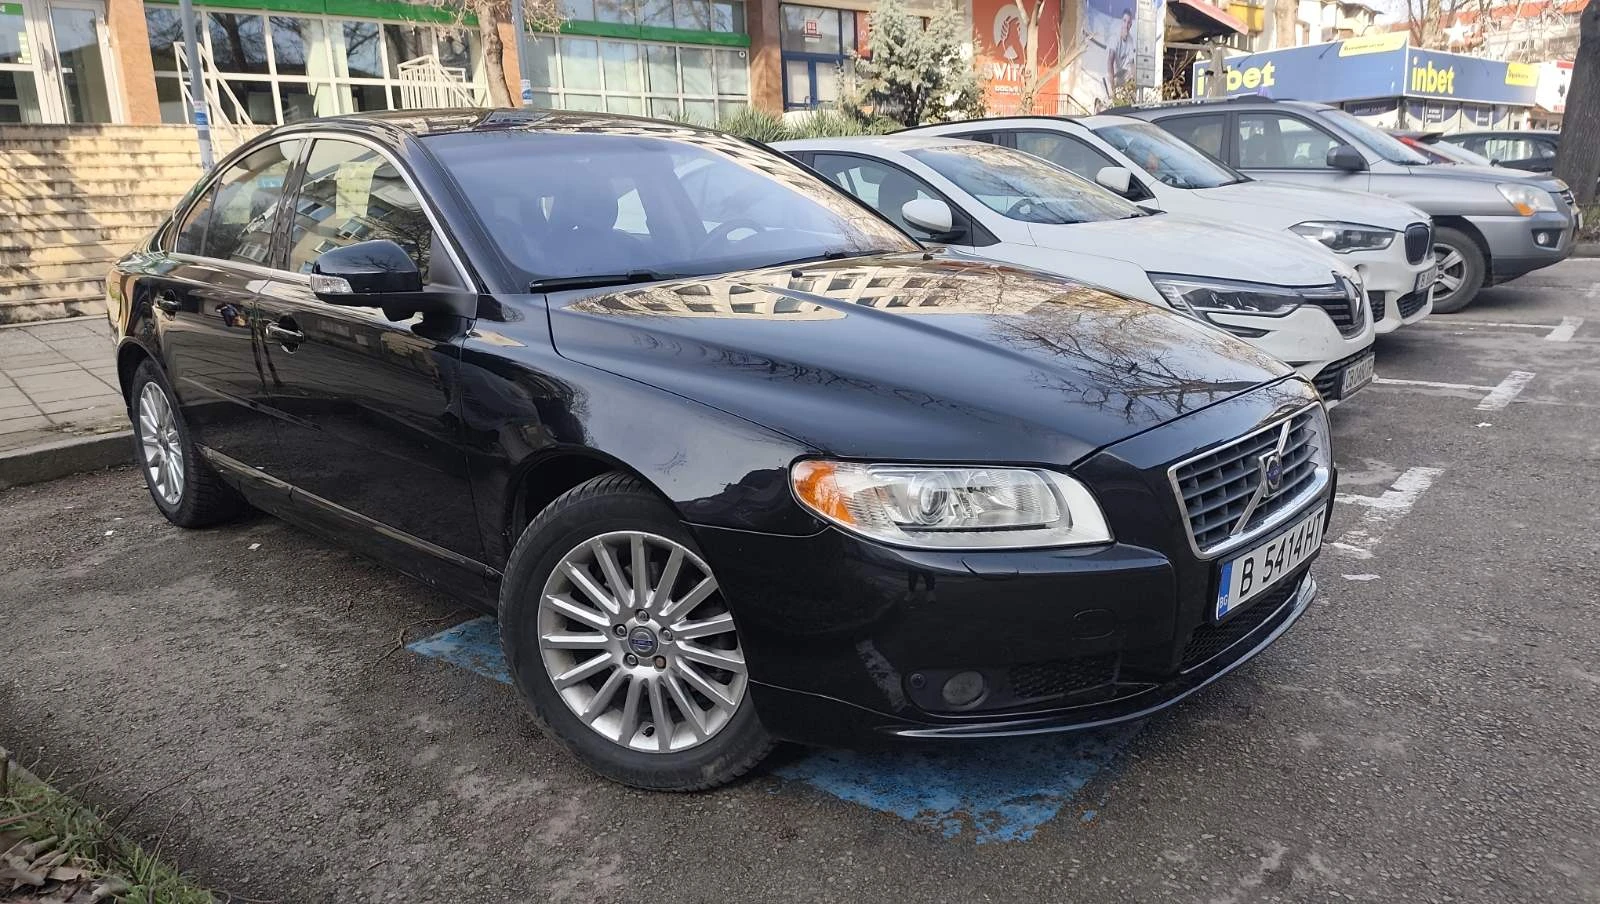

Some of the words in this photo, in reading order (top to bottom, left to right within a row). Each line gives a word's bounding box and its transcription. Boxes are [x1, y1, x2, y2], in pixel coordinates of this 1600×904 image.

[1197, 60, 1276, 96] ibet
[1411, 56, 1455, 95] inbet
[1239, 556, 1254, 598] B
[1262, 509, 1324, 583] 5414HT
[1218, 593, 1229, 609] BG
